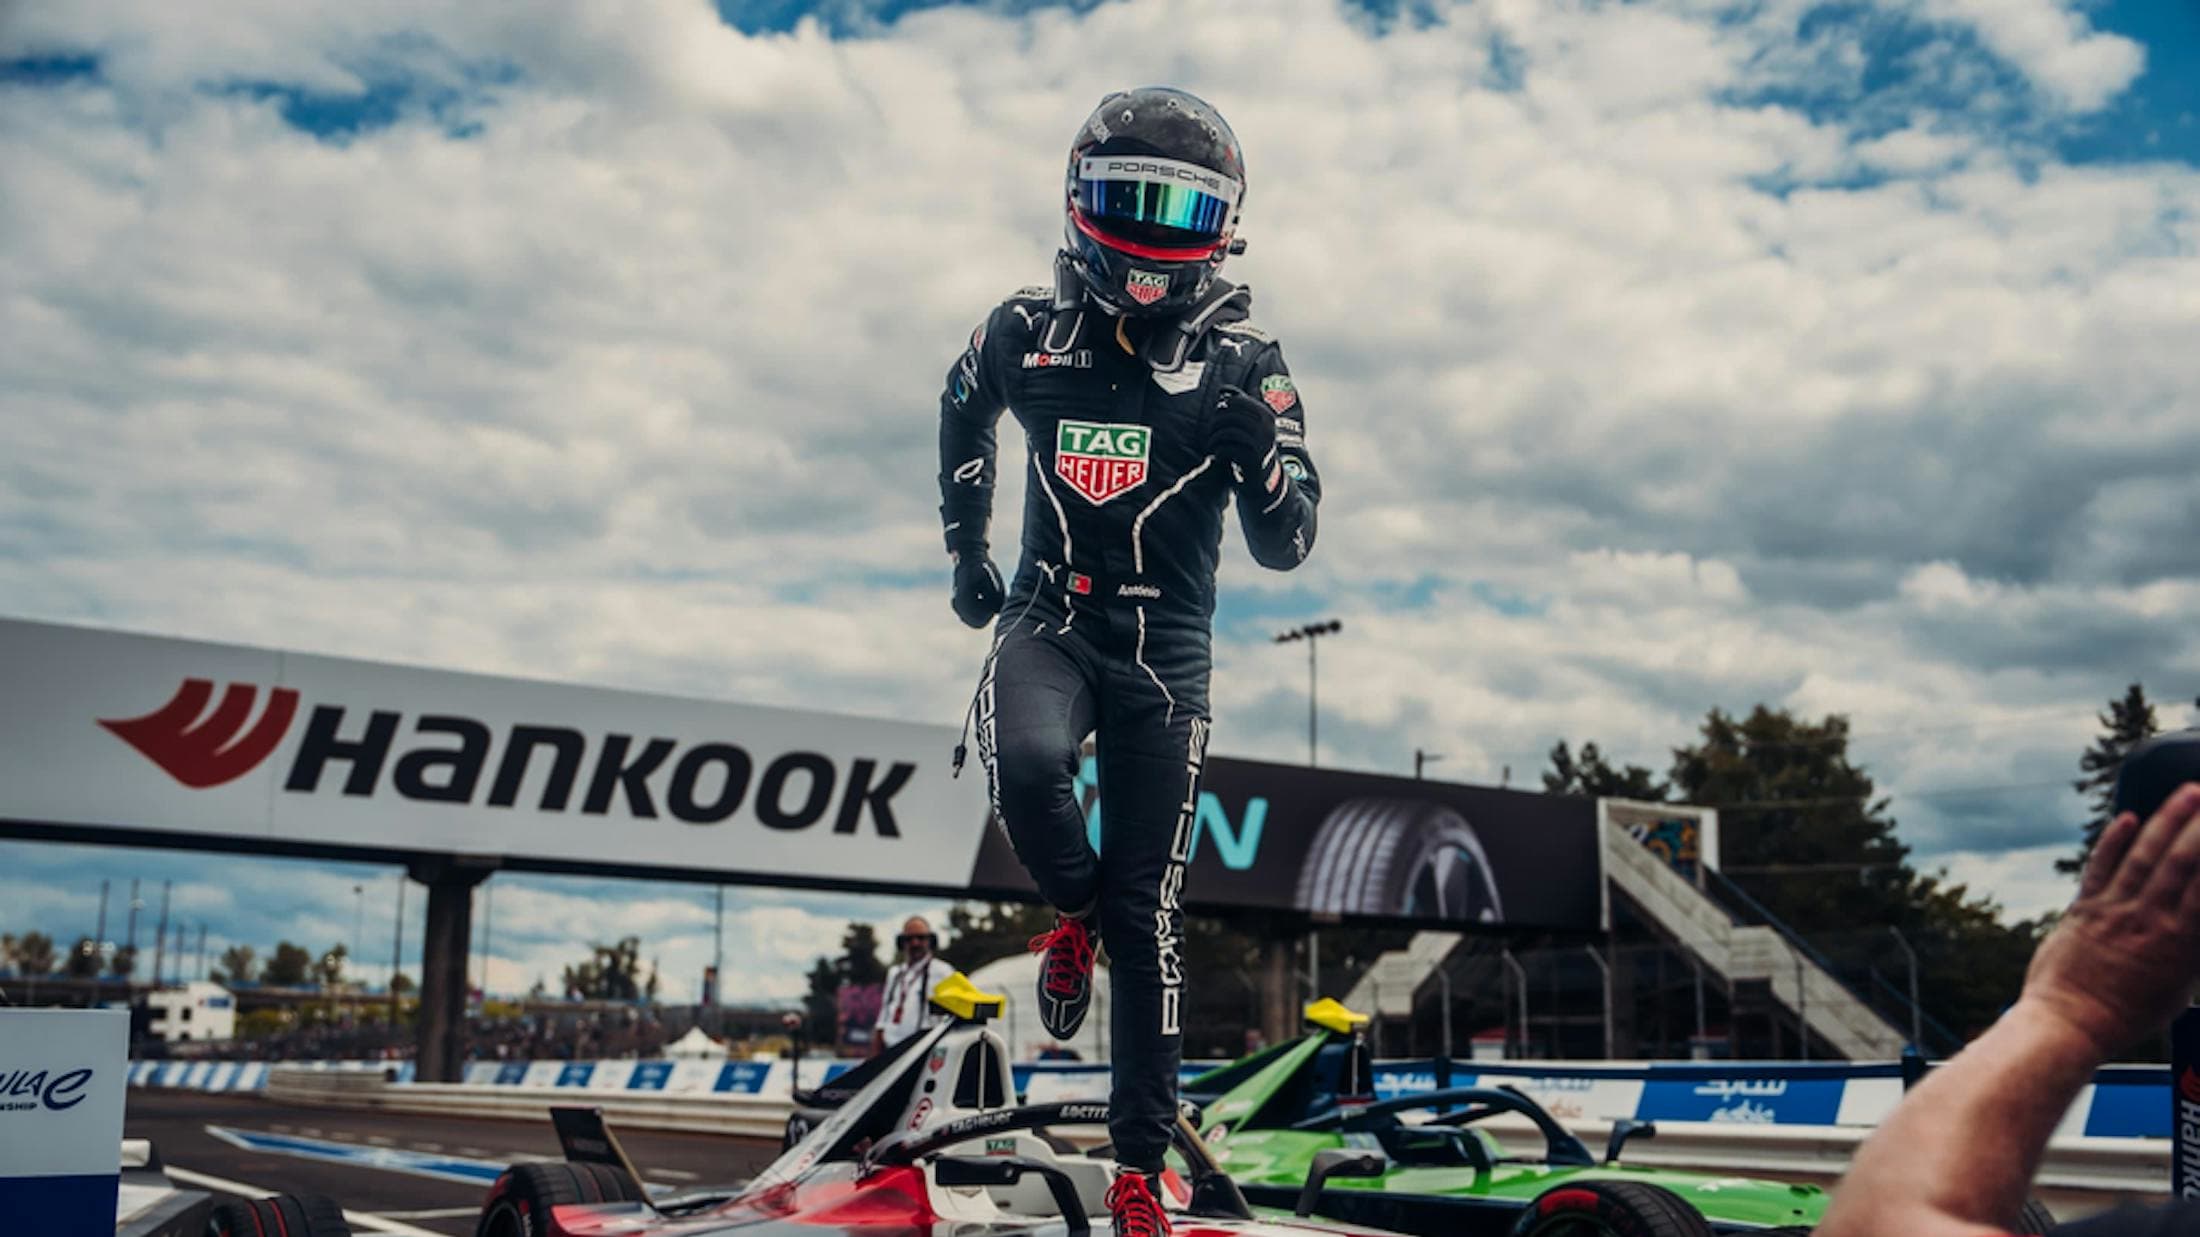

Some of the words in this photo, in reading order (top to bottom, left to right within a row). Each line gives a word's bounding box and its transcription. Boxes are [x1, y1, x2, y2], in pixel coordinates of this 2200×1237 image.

[1108, 162, 1220, 190] PORSCHE
[1133, 272, 1165, 287] TAG
[1065, 427, 1142, 455] TAG
[1061, 457, 1142, 498] HEUER
[1155, 716, 1210, 1036] PORSCHE
[1059, 1104, 1109, 1120] LOCTIT
